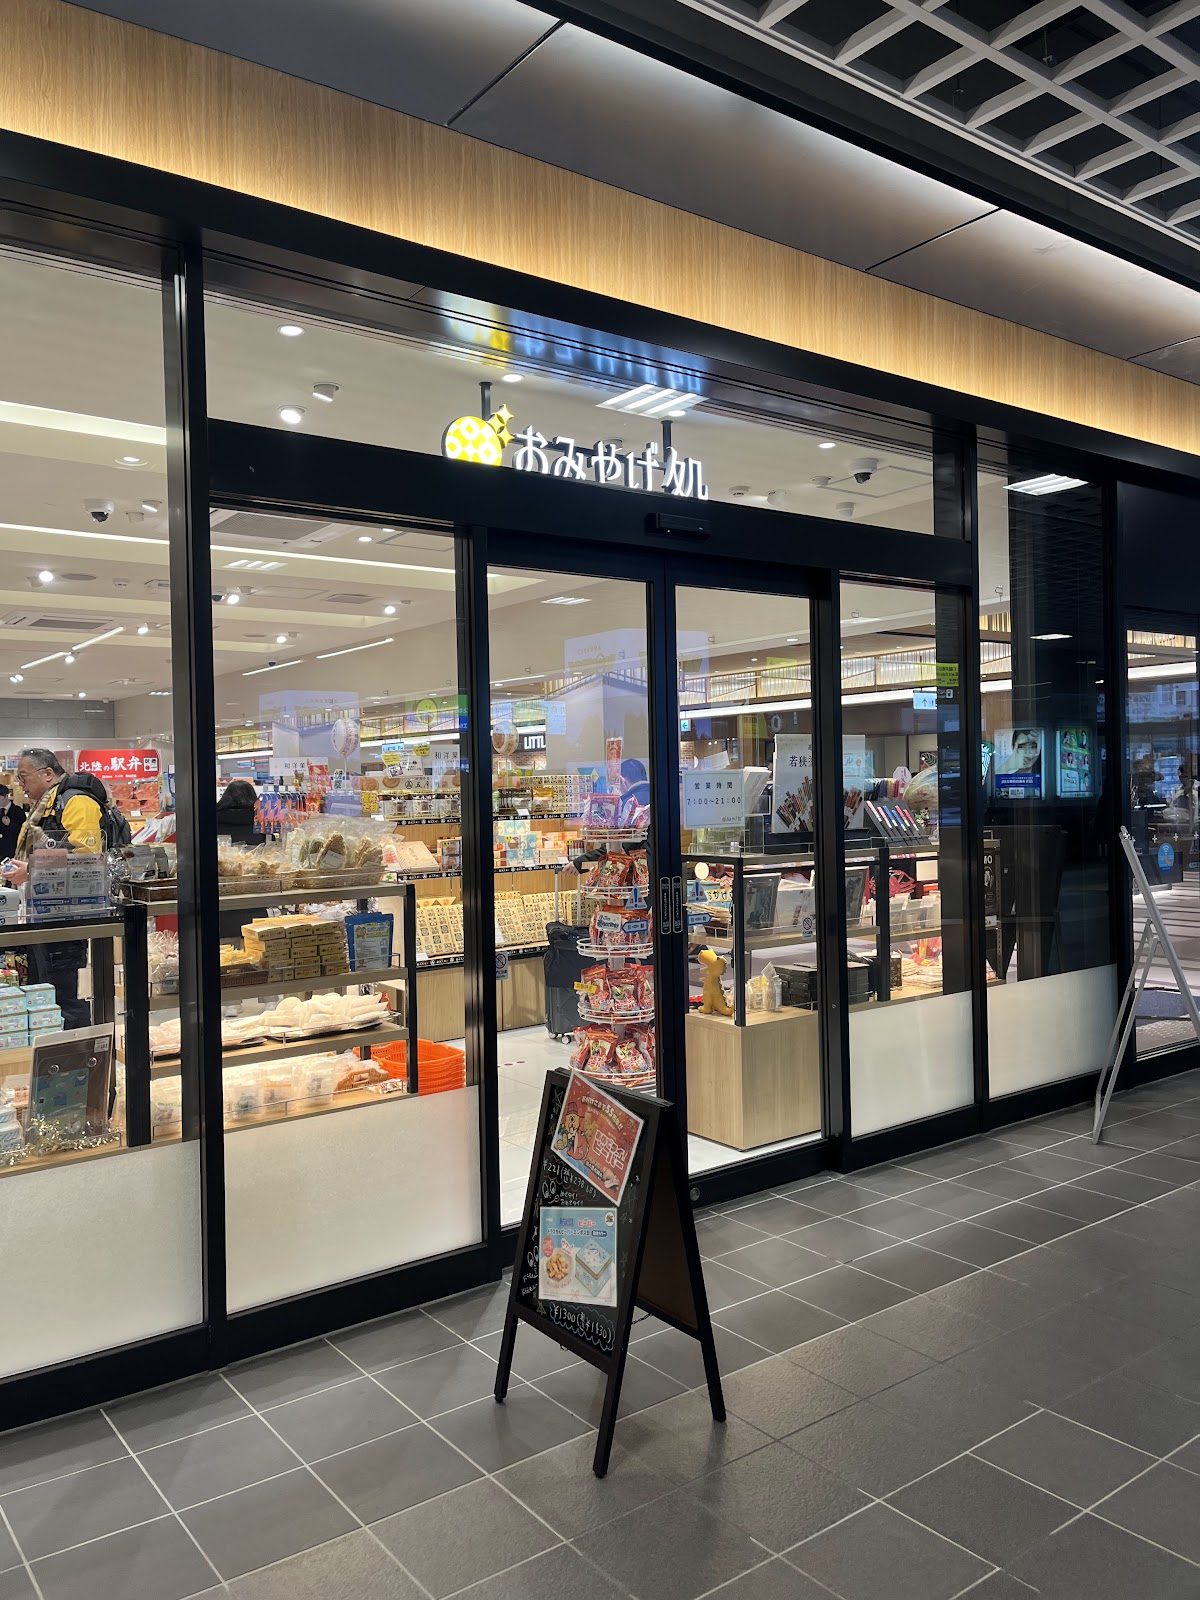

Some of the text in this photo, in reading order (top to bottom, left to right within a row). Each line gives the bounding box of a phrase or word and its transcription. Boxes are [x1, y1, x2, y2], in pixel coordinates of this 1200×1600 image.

[512, 424, 709, 501] おみやげ処
[79, 755, 142, 772] 北陸の駅弁
[694, 781, 733, 790] 営業時間
